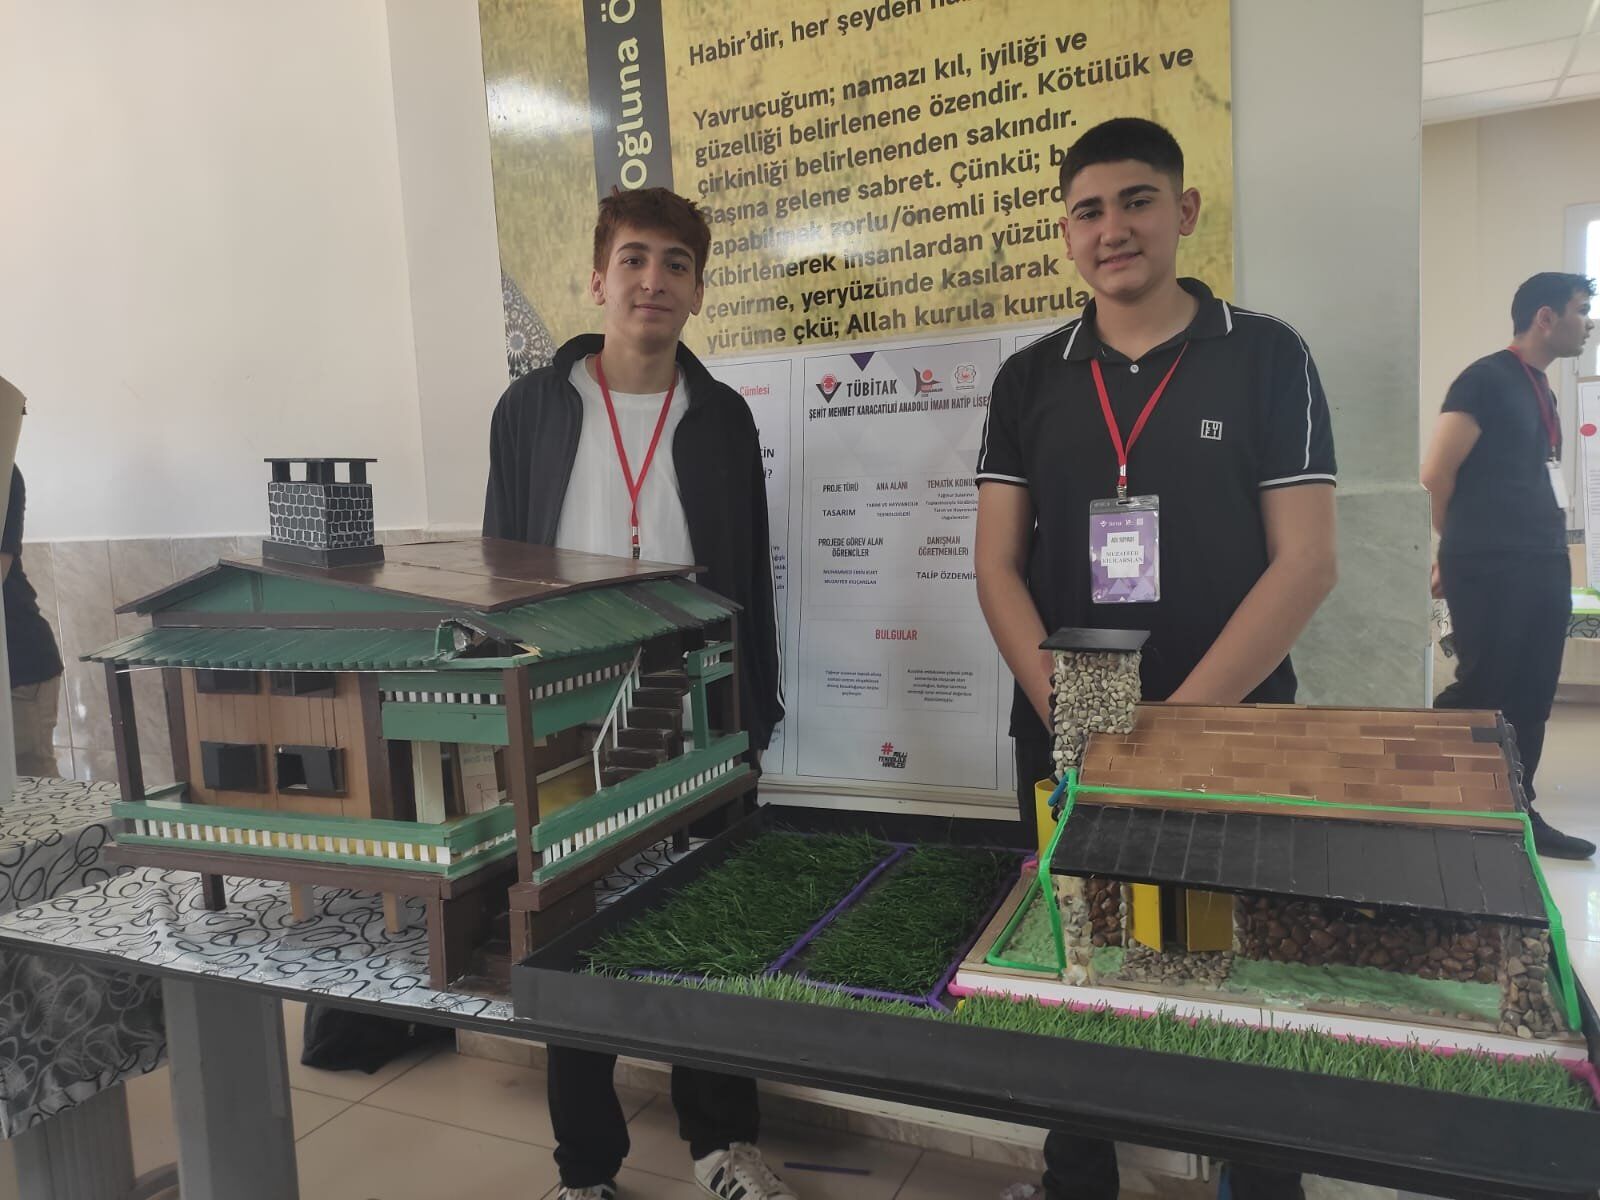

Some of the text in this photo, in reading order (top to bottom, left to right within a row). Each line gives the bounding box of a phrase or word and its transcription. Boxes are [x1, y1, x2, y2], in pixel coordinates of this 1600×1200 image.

[791, 16, 830, 43] her
[837, 0, 922, 36] şeyden
[693, 31, 1088, 131] Yavrucuğum; namazı kıl, iyiliği ve
[616, 37, 653, 190] Oğluna
[694, 47, 1195, 168] güzelliği belirlenene özendir. Kötülük ve
[697, 107, 1078, 199] çirkinliği belirlenenden sakındır.
[702, 143, 1072, 226] Başına gelene sabret. Çünkü; b
[710, 220, 823, 259] apabilmek
[831, 191, 985, 237] zorlu/önemli
[703, 252, 837, 289] Kibirlenerek
[844, 231, 984, 270] insanlardan
[705, 254, 1060, 323] çevirme, yeryüzünde kasılarak
[707, 286, 1090, 350] yürüme çkü; Allah kurula kurula
[809, 405, 827, 421] ŞEHİT
[828, 405, 856, 418] MEHMET
[899, 400, 929, 413] ANADOLU
[930, 397, 950, 411] İMAM
[951, 396, 971, 409] HATİP
[847, 378, 898, 398] TÜBİTAK
[822, 484, 842, 493] PROJE
[876, 481, 908, 491] ANA ALANI
[822, 509, 856, 517] TASARIM
[818, 537, 884, 547] PROJEDE GÖREV ALAN
[916, 571, 939, 580] TALİP
[875, 629, 918, 641] BULGULAR
